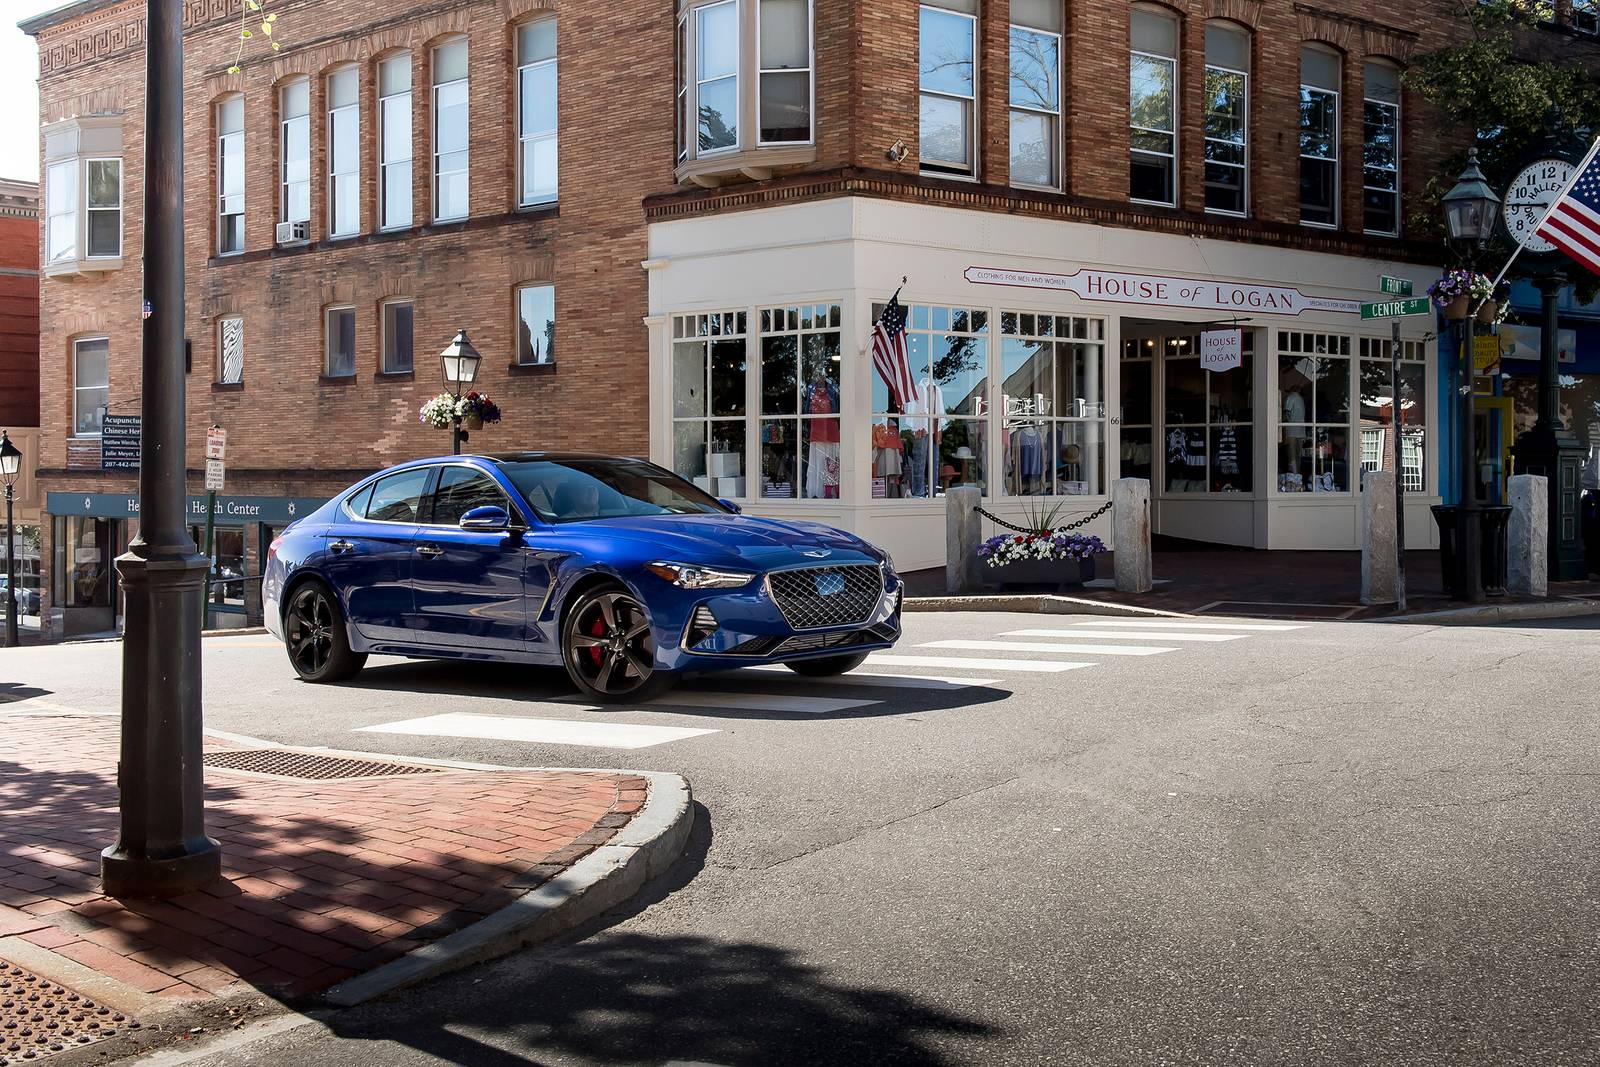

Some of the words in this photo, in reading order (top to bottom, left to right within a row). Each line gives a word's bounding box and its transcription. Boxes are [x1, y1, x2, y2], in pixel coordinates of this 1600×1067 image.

[1542, 166, 1556, 179] 12
[1562, 170, 1567, 182] 1
[1526, 174, 1536, 186] 11
[1516, 187, 1527, 198] 10
[1528, 182, 1562, 200] HALLET
[1512, 202, 1520, 216] 9
[1524, 207, 1538, 225] DRU
[1516, 220, 1524, 230] 8
[978, 272, 1004, 280] CLOTHING
[1044, 278, 1066, 286] WOMEN
[1087, 276, 1168, 300] HOUSE
[1180, 286, 1205, 302] of
[1215, 287, 1293, 308] LOGAN
[1372, 302, 1406, 316] CENTRE
[1206, 336, 1236, 347] HOUSE
[1205, 352, 1236, 362] LOGAN
[1110, 417, 1120, 425] 66
[127, 500, 139, 512] He
[192, 500, 224, 514] Heth
[227, 502, 260, 515] Center
